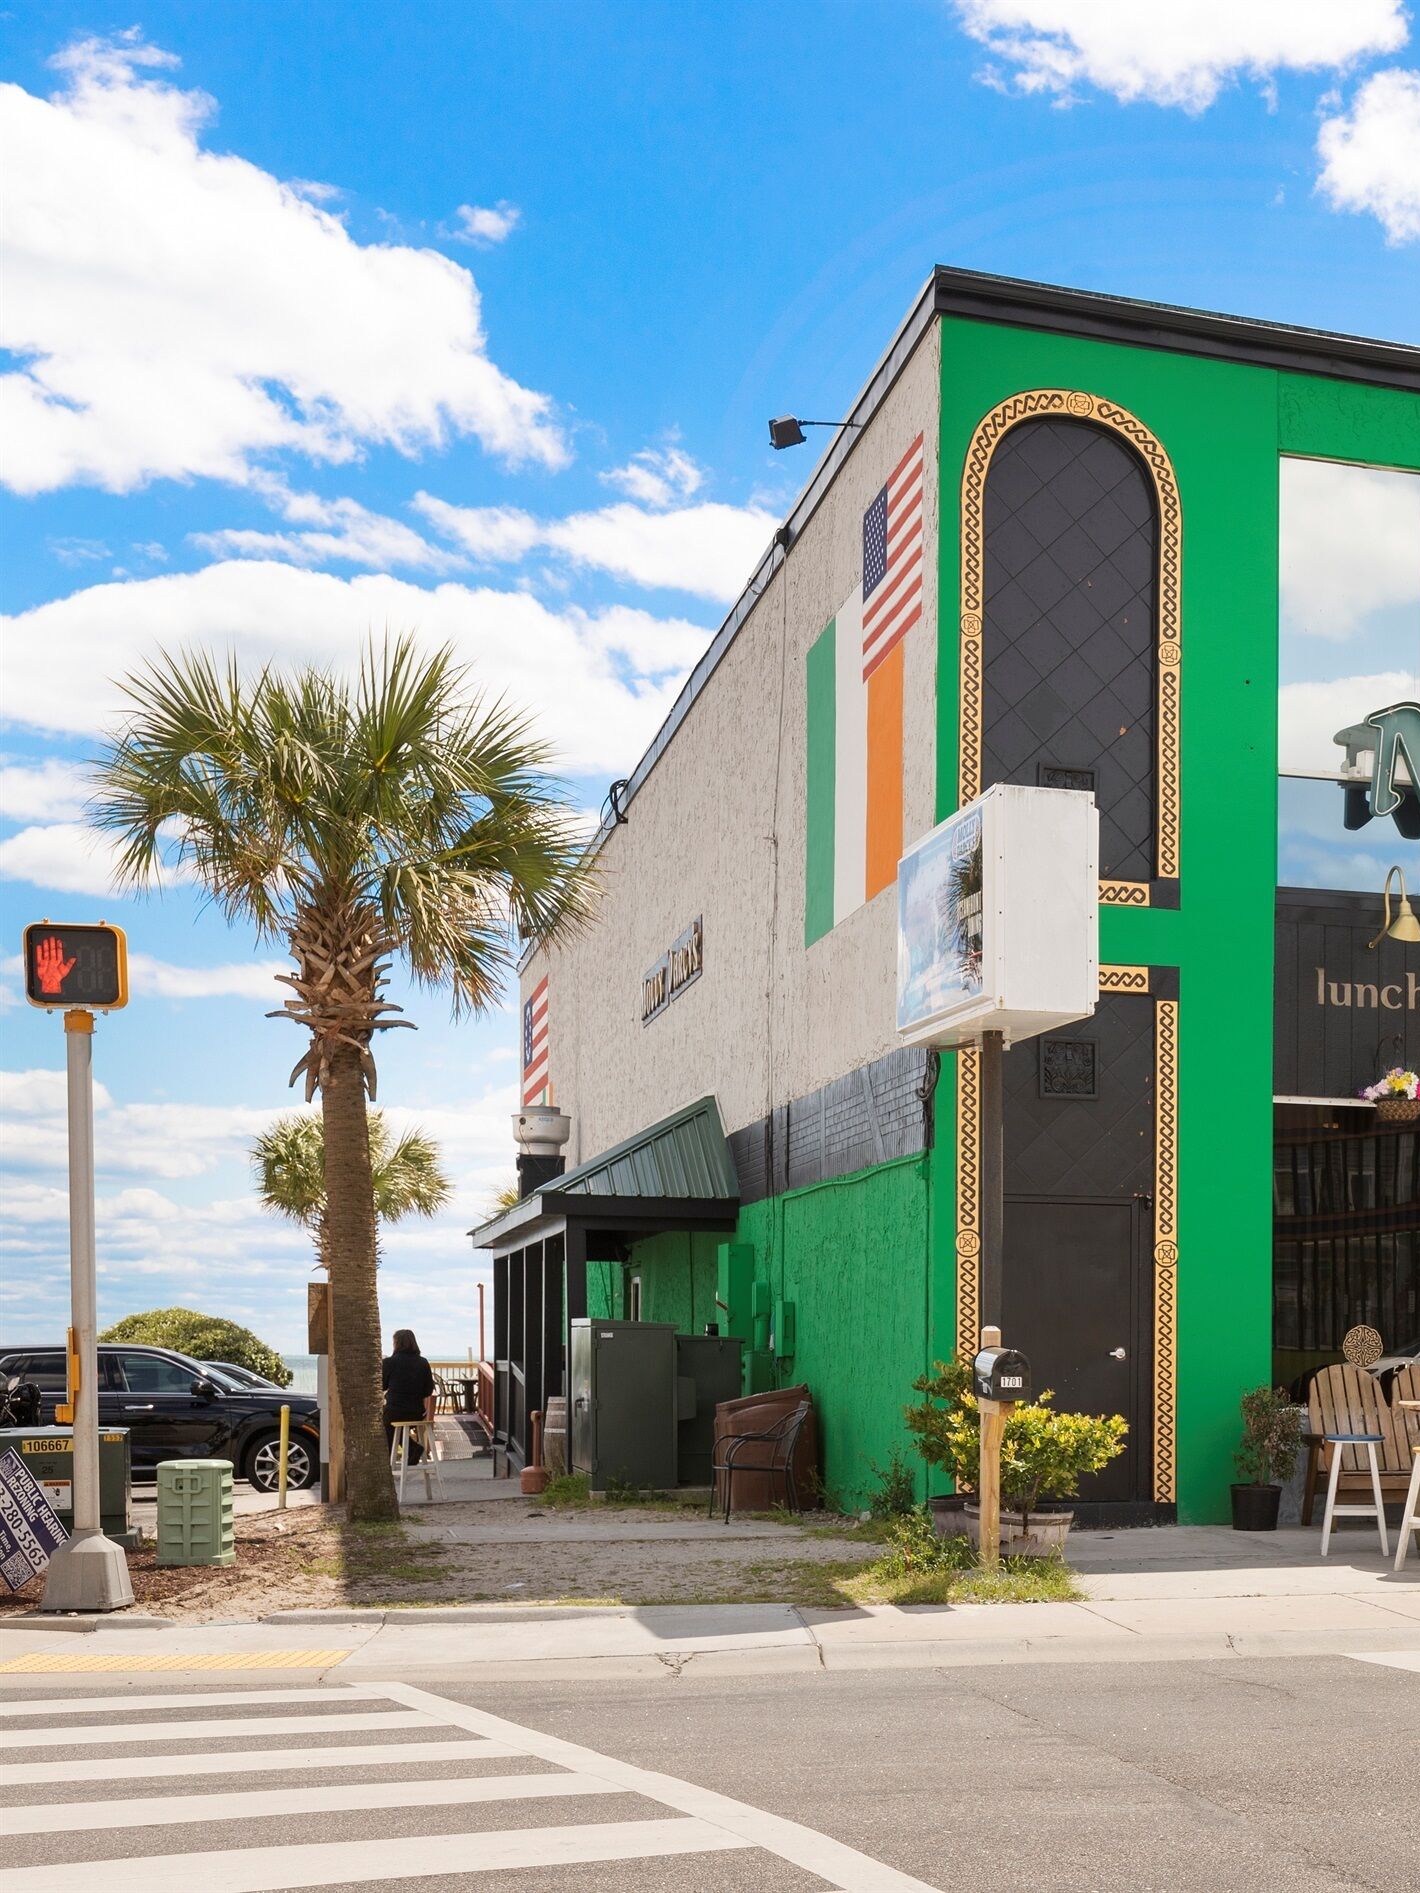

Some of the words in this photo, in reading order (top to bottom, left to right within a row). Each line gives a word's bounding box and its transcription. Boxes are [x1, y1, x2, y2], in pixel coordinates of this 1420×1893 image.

[1001, 1377, 1022, 1387] 1701
[26, 1439, 70, 1452] 106667
[6, 1475, 39, 1523] REZONING
[15, 1468, 43, 1507] PUBLIC
